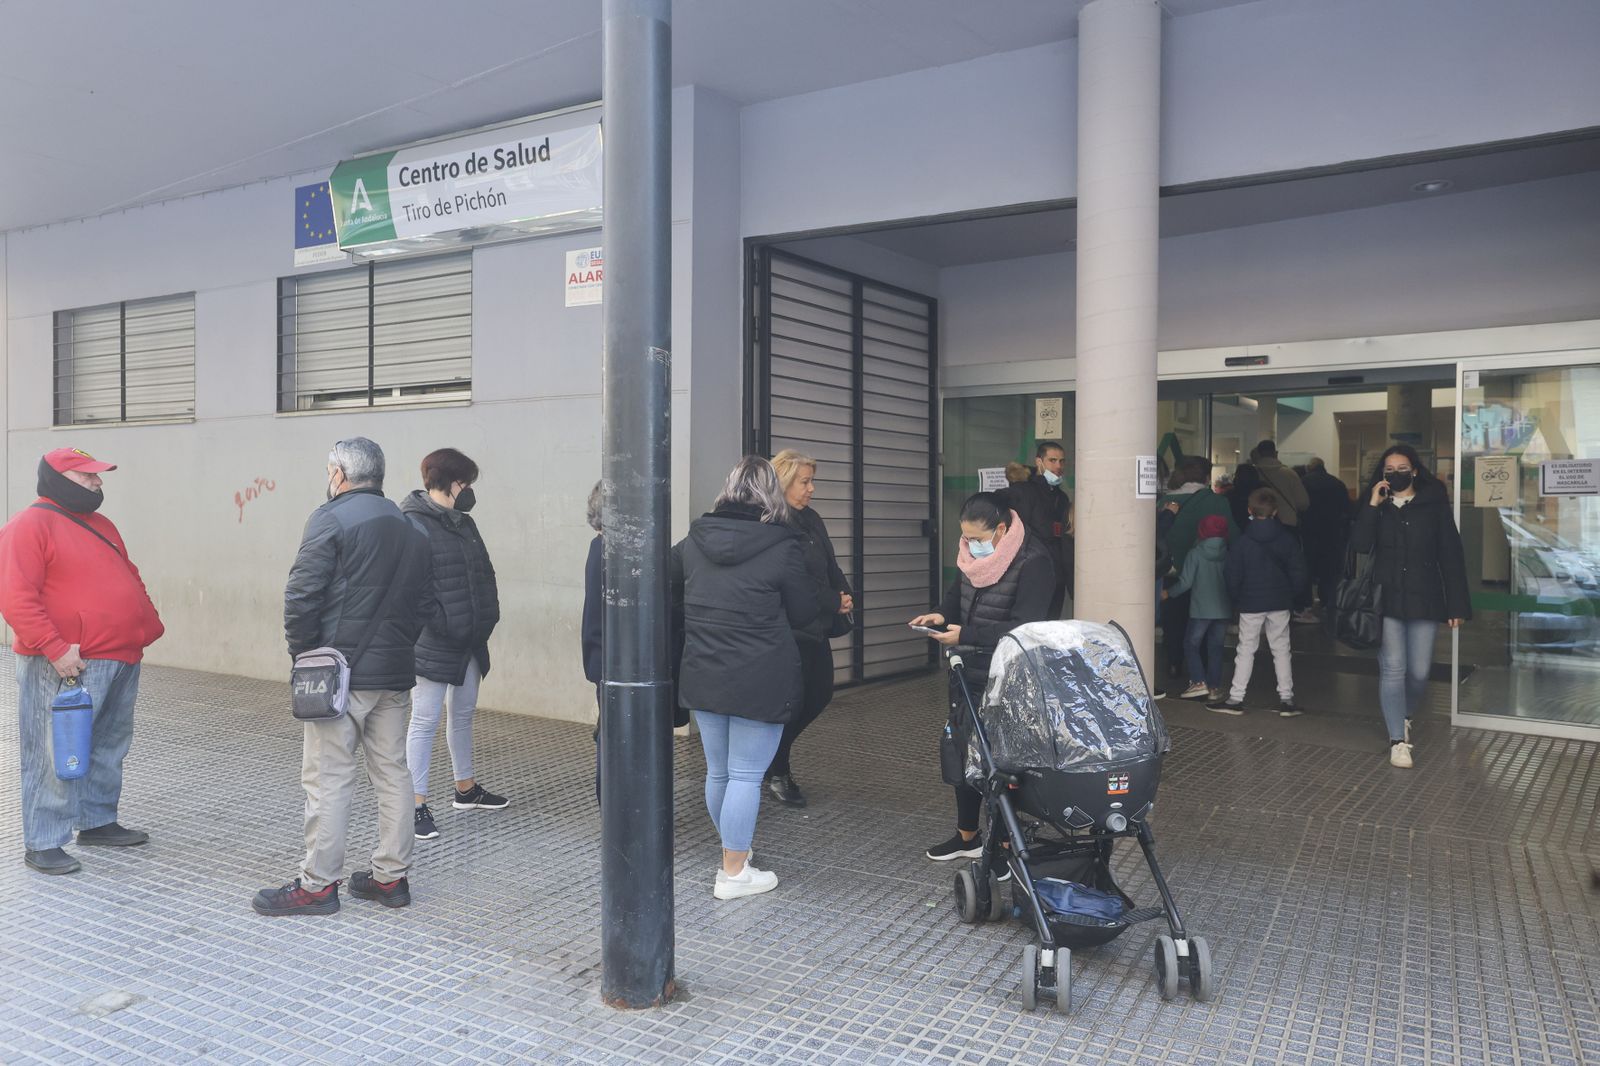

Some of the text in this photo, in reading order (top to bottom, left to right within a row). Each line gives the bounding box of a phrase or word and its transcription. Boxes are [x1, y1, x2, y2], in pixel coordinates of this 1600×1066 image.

[399, 137, 551, 187] Centro de Salud
[402, 187, 507, 222] Tiro de Pichón
[590, 250, 602, 259] EU
[568, 270, 603, 285] ALAR
[295, 680, 328, 695] FILA
